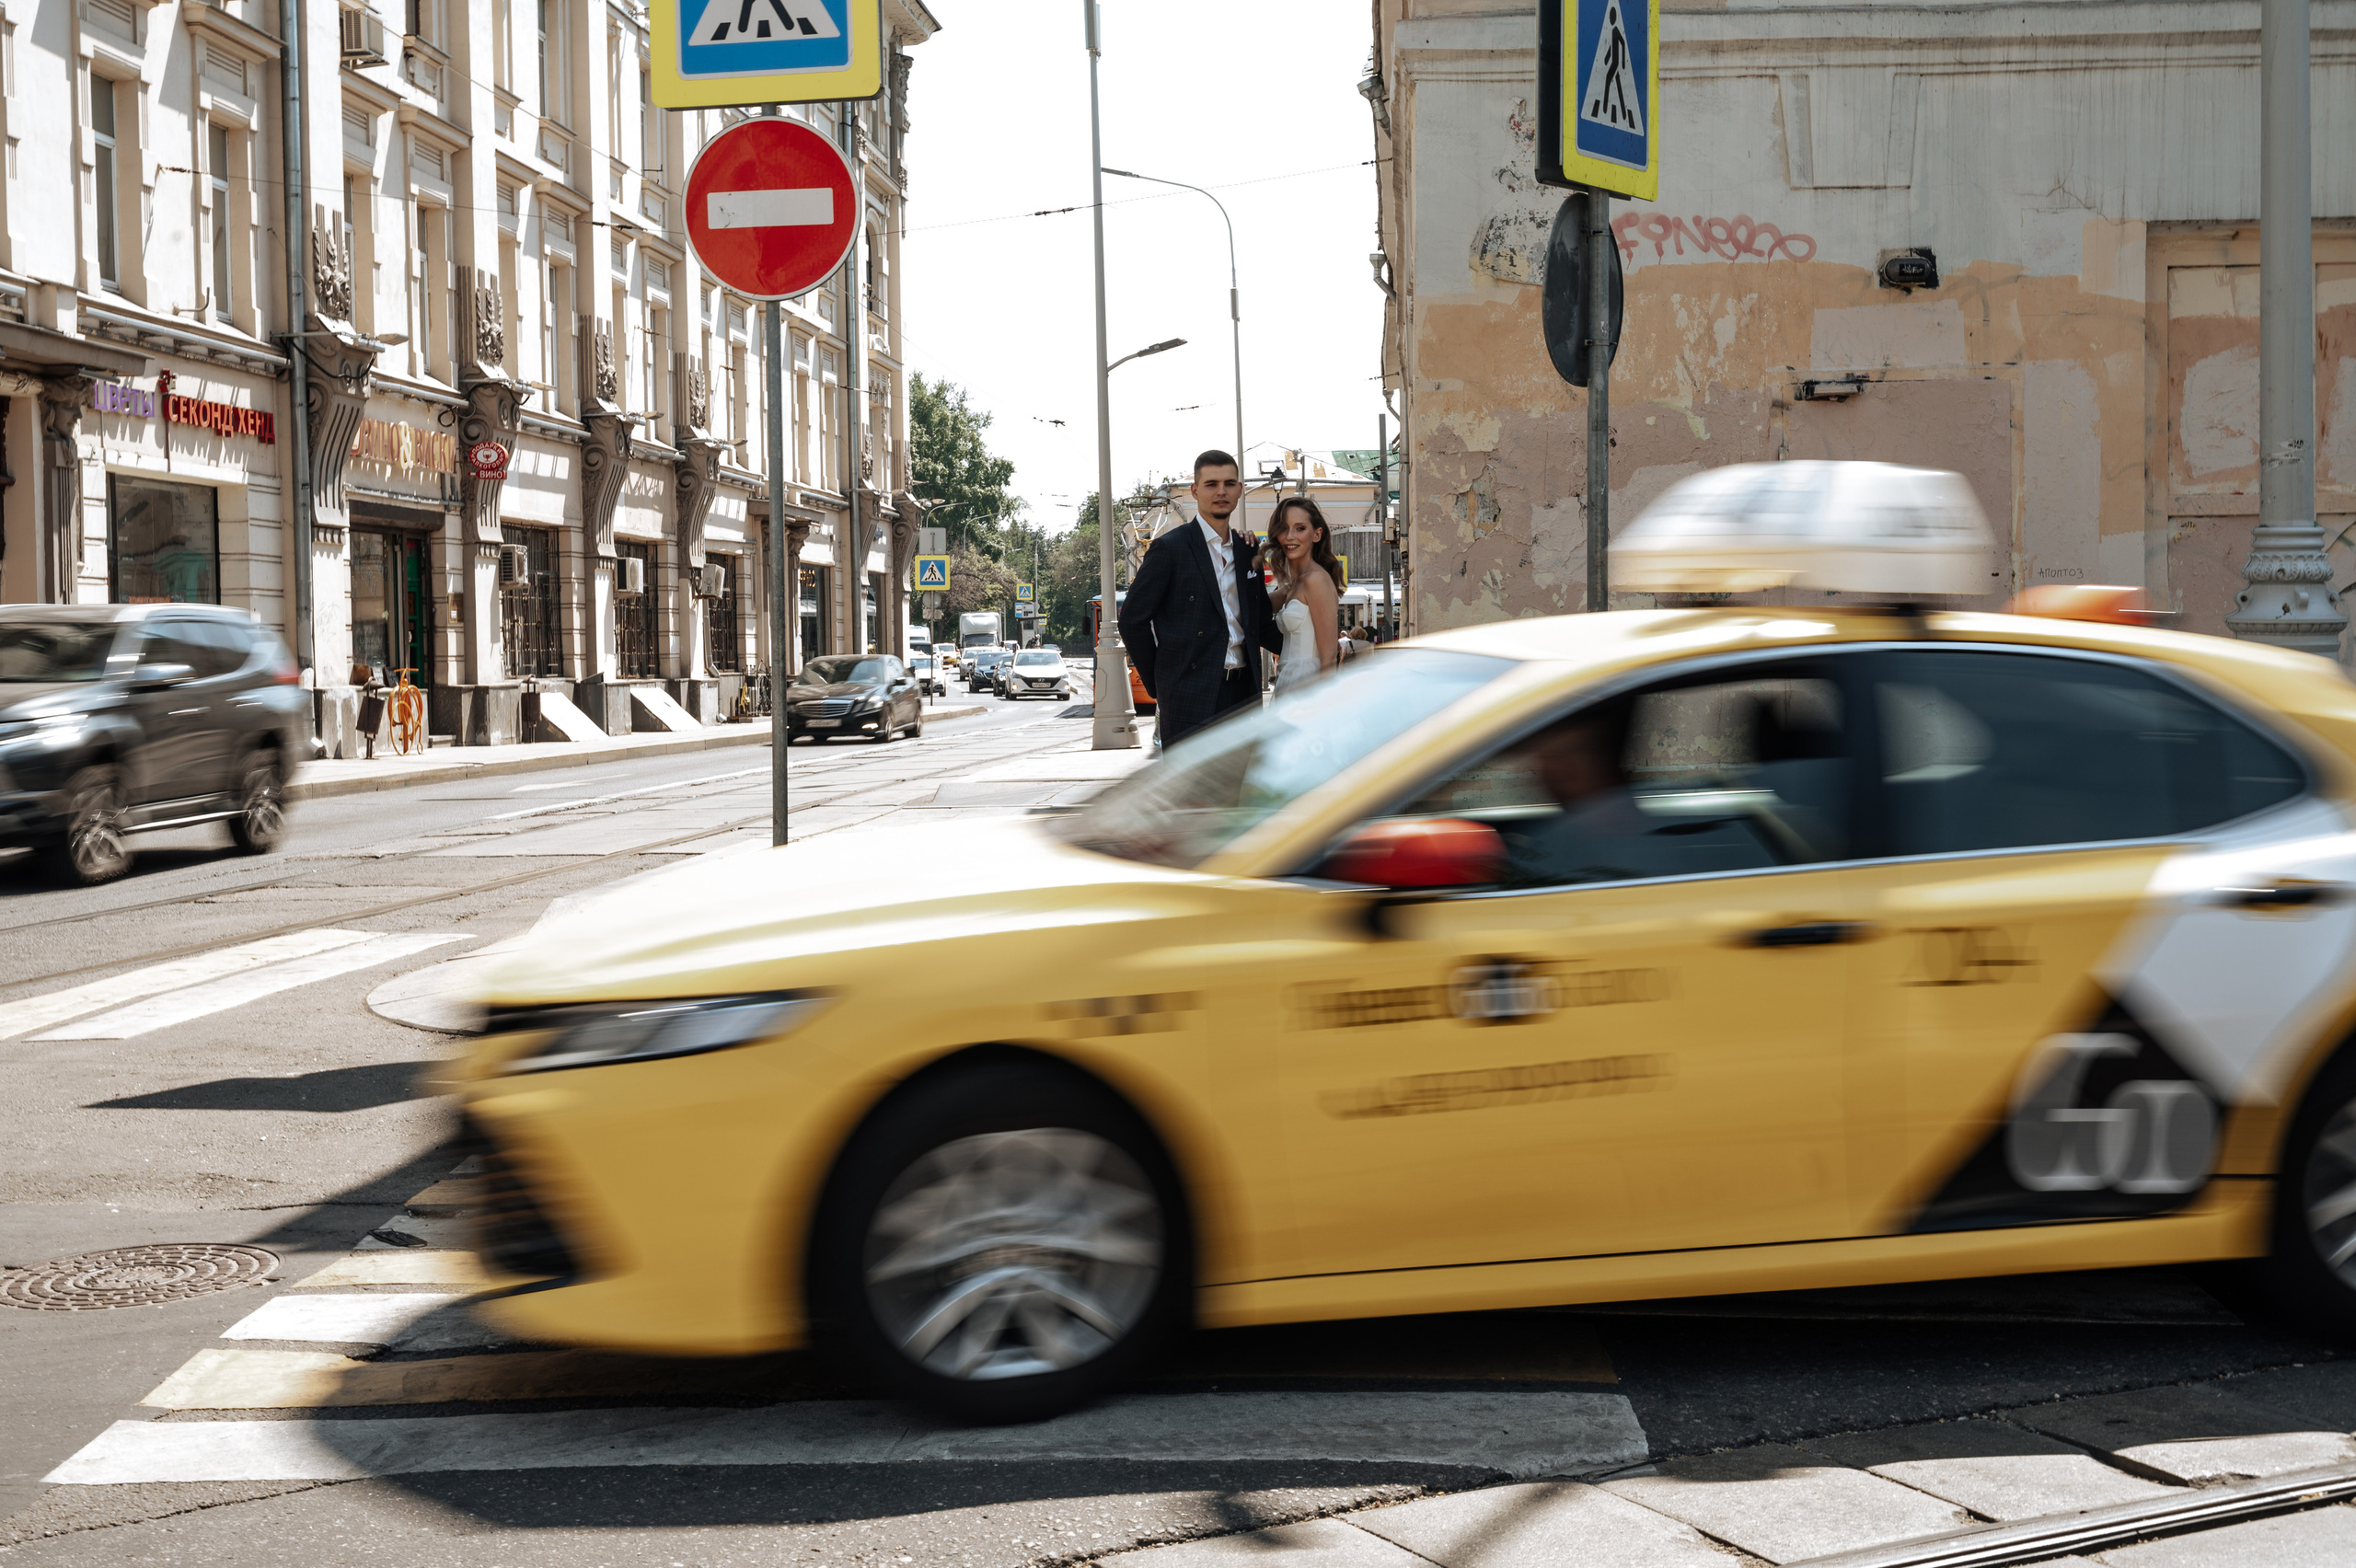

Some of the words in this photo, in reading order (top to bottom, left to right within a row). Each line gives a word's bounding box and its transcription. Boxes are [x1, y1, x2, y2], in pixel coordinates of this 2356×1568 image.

[168, 394, 234, 439] СЕКОНД
[238, 407, 275, 444] ХЕНД
[362, 419, 400, 464] ВИНО
[414, 428, 456, 474] ВИСКИ
[471, 443, 502, 455] ПОДАРКИ
[471, 456, 504, 469] АЛКОГОЛЬ
[479, 470, 503, 478] ВИНО
